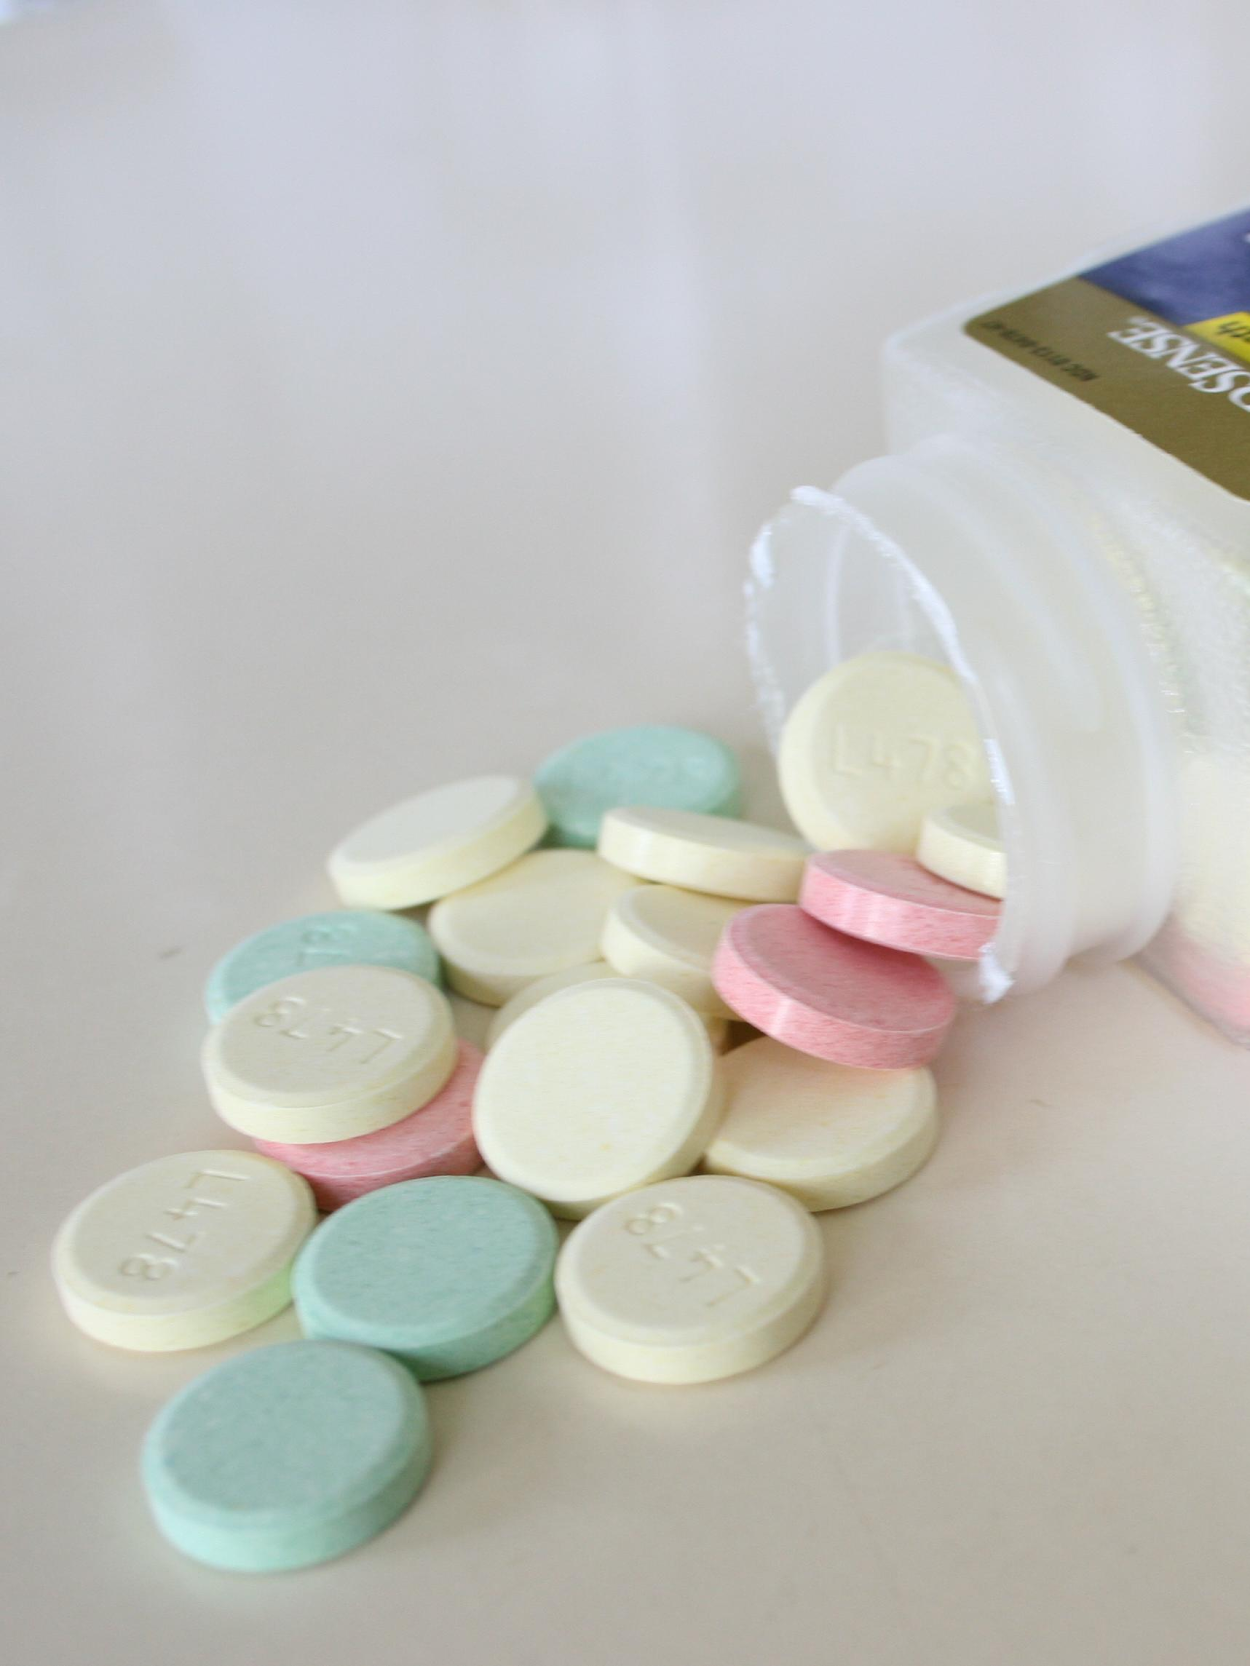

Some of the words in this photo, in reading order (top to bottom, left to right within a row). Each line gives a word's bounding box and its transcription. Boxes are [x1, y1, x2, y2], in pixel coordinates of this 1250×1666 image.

[832, 722, 980, 792] L478
[255, 996, 404, 1064] L478
[120, 1167, 250, 1281] L478
[624, 1201, 761, 1307] L478
